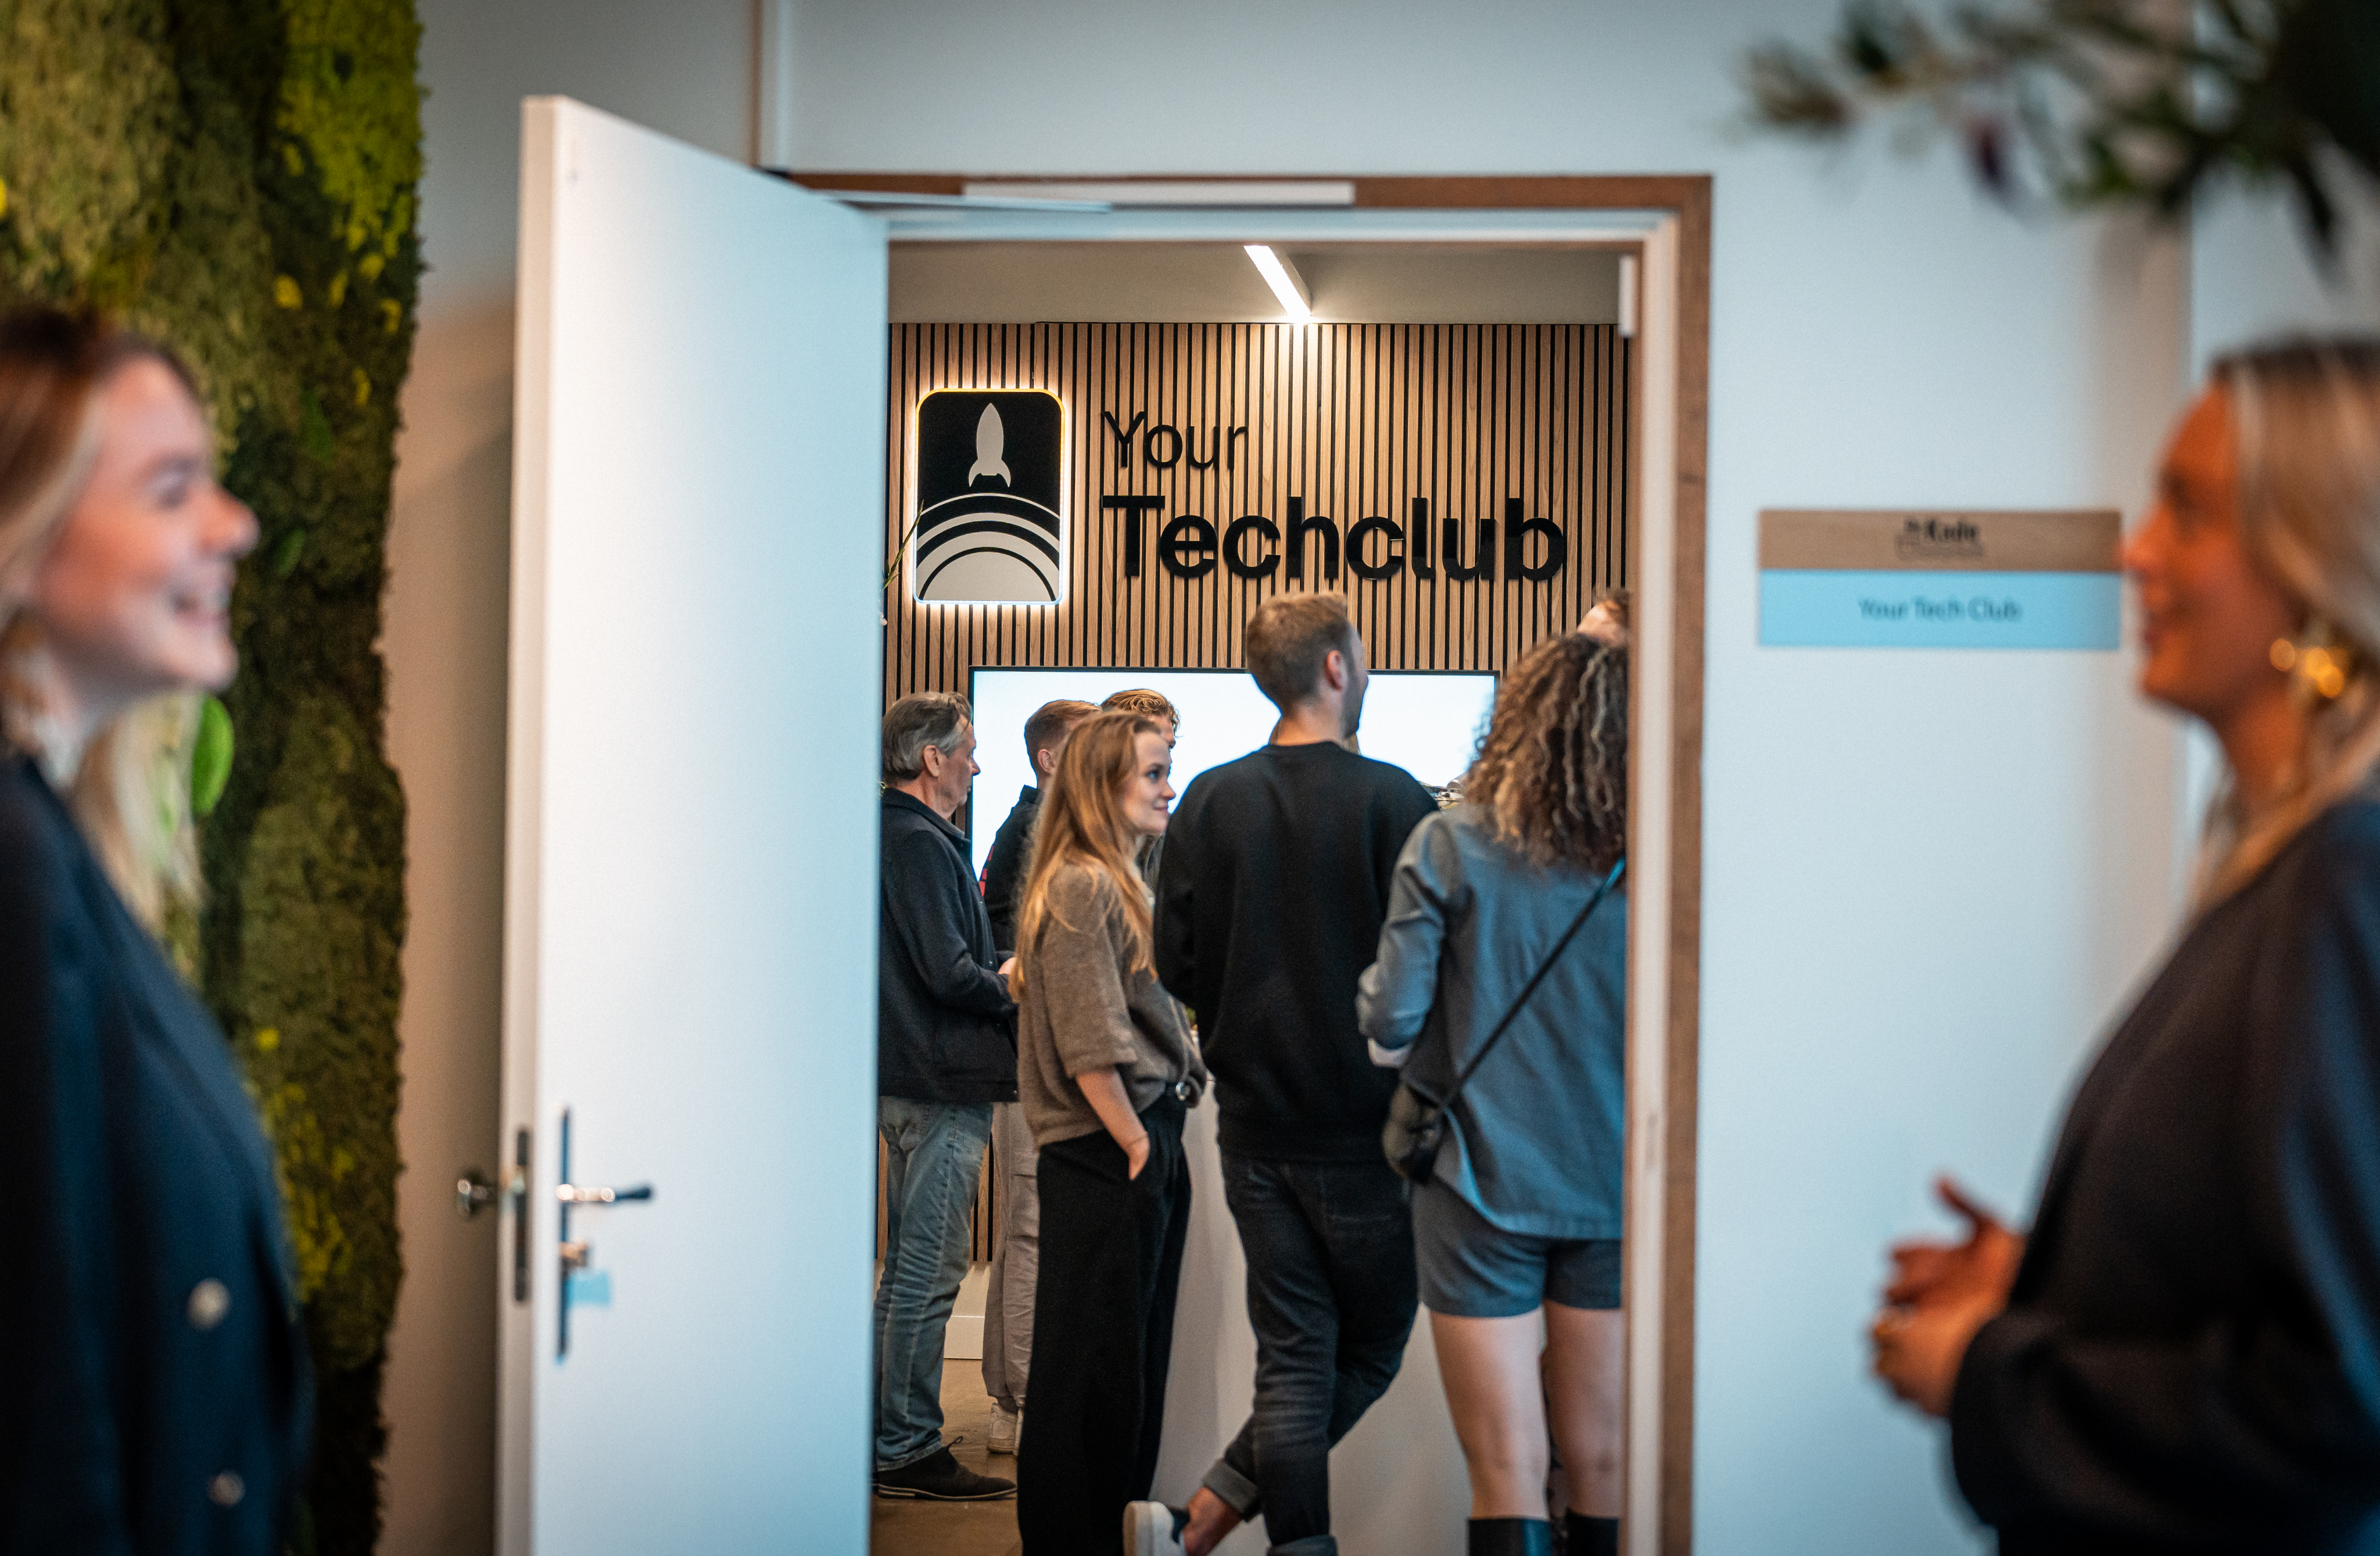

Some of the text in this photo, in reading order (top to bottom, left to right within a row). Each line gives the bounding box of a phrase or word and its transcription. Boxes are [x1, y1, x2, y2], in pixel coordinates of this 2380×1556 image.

[1102, 410, 1248, 470] Your
[1102, 495, 1566, 581] Techclub
[1858, 596, 2023, 622] Your Tech Club
